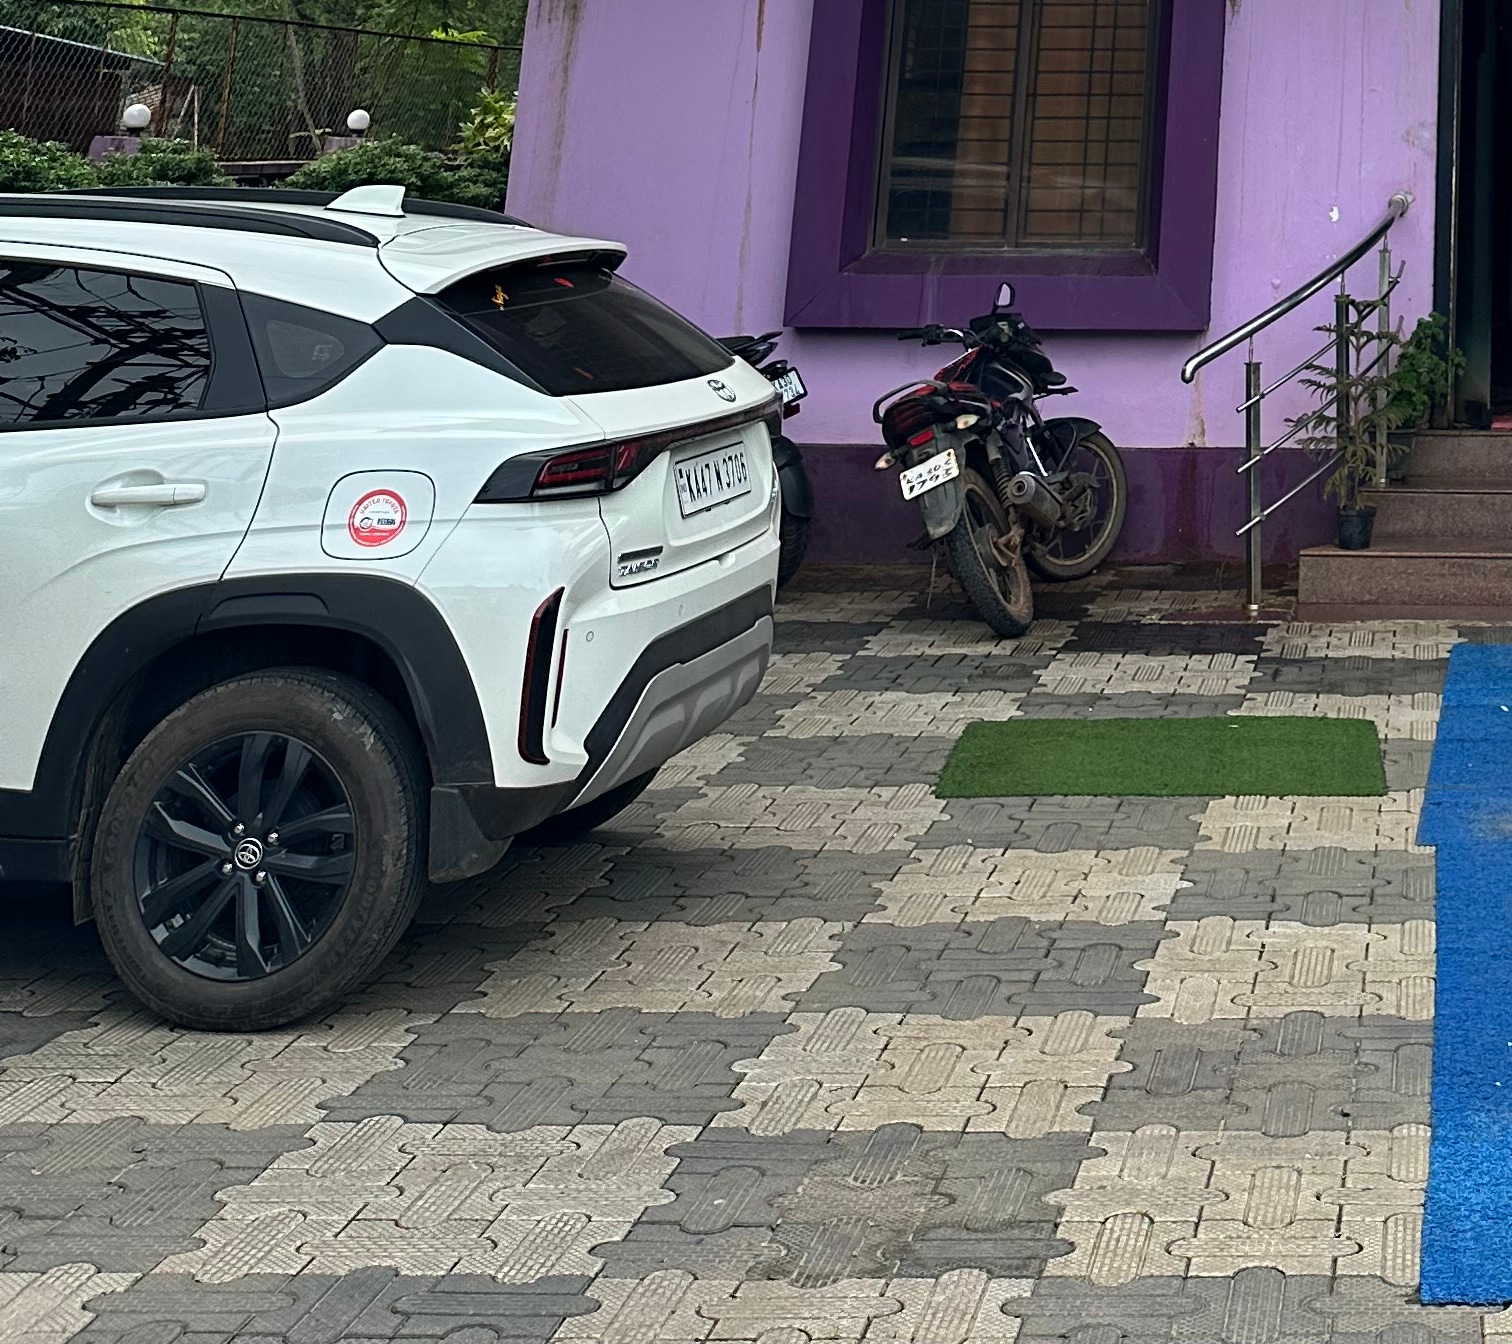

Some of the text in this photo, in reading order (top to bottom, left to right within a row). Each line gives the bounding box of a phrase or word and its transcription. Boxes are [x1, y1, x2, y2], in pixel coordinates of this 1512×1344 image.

[685, 451, 748, 503] KA47 N 3706
